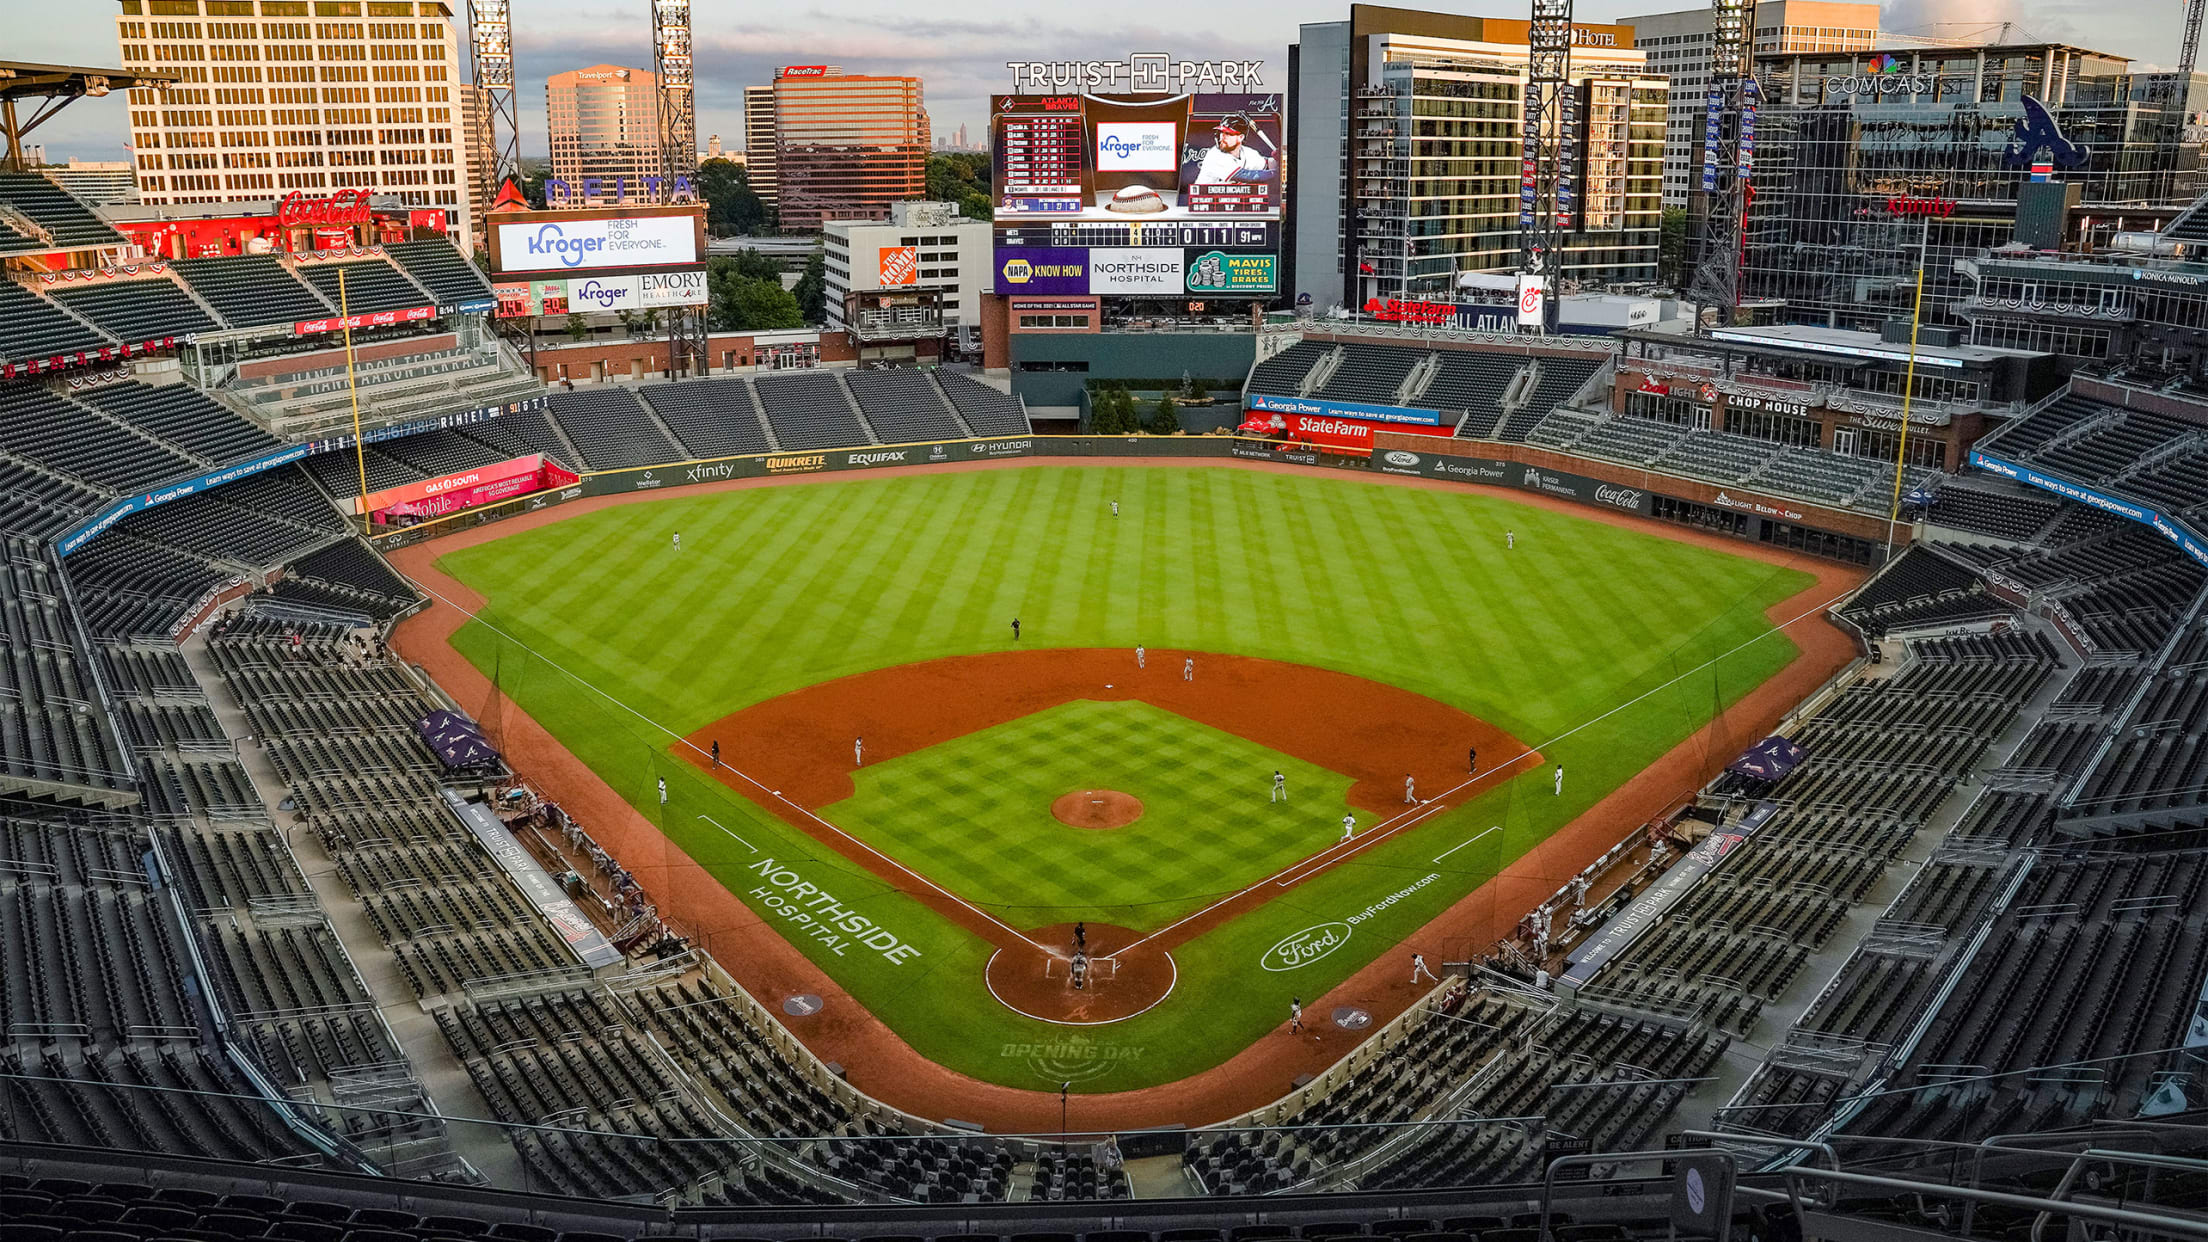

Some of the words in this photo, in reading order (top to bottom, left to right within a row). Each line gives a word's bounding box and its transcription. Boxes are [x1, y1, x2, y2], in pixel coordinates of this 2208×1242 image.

[1578, 28, 1618, 46] HOTEL
[578, 71, 612, 80] Travelport
[786, 67, 823, 76] RaceTrac
[1007, 61, 1123, 87] TRUIST
[1179, 60, 1264, 87] PARK
[1826, 75, 1934, 94] COMCAST
[1100, 135, 1142, 159] Kroger
[545, 176, 696, 207] DELTA
[279, 187, 375, 227] Coca-Cola
[1887, 193, 1957, 218] xfinity
[607, 219, 638, 230] FRESH
[608, 230, 630, 240] FOR
[1184, 229, 1192, 244] 0
[1203, 229, 1209, 244] 1
[1221, 229, 1227, 244] 1
[1240, 231, 1251, 243] 91
[528, 223, 606, 267] Kroger
[609, 239, 662, 250] EVERYONE
[880, 246, 917, 284] HOME
[882, 251, 898, 266] THE
[1228, 259, 1271, 268] MAVIS
[894, 261, 916, 284] DEPOT
[1007, 264, 1029, 278] NAPA
[1034, 265, 1060, 277] KNOW
[1062, 265, 1083, 277] HOW
[1094, 263, 1180, 274] NORTHSIDE
[642, 272, 704, 291] EMORY
[1110, 275, 1164, 283] HOSPITAL
[2141, 271, 2168, 282] KONICA
[2168, 274, 2198, 285] MINOLTA
[578, 280, 628, 307] Kroger
[642, 289, 702, 300] HEALTHCARE
[373, 312, 395, 324] Coca-Cola
[406, 308, 428, 319] Coca-Cola
[440, 305, 454, 314] 8:14
[303, 321, 327, 332] Coca-Cola
[1477, 315, 1520, 334] ATLAN
[1638, 380, 1669, 395] Coors
[1669, 387, 1697, 399] LIGHT
[1267, 400, 1297, 412] Georgia
[1298, 404, 1322, 414] Power
[1328, 408, 1344, 416] Learn
[1344, 410, 1358, 418] ways
[1385, 414, 1435, 423] georgiapower.com
[1728, 395, 1761, 409] CHOP
[1765, 400, 1808, 417] HOUSE
[441, 417, 448, 428] R
[456, 413, 463, 425] H
[472, 410, 477, 422] E
[1850, 416, 1862, 424] THE
[989, 440, 1032, 451] HYUNDAI
[766, 455, 827, 469] QUIKRETE
[848, 451, 906, 465] EQUIFAX
[1391, 452, 1414, 465] Ford
[154, 490, 176, 503] Georgia
[177, 485, 194, 498] Power
[206, 475, 222, 486] Learn
[222, 471, 236, 483] ways
[236, 468, 243, 477] to
[243, 466, 256, 475] save
[256, 464, 262, 472] at
[262, 449, 305, 471] georgiapower.com
[686, 463, 734, 482] xfinity
[1447, 464, 1478, 477] Georgia
[1480, 467, 1504, 478] Power
[426, 483, 443, 494] GAS
[452, 473, 479, 487] SOUTH
[473, 482, 498, 495] AMERICA'S
[498, 479, 511, 489] MOST
[511, 474, 533, 487] RELIABLE
[499, 484, 520, 495] COVERAGE
[636, 478, 661, 487] Wellstar
[1984, 459, 2002, 474] Georgia
[2002, 465, 2018, 477] Power
[2028, 473, 2044, 485] Learn
[2044, 478, 2059, 490] ways
[2058, 483, 2066, 492] to
[2066, 486, 2079, 496] save
[2080, 490, 2087, 499] at
[2087, 493, 2142, 519] georgiapower.com
[1595, 484, 1642, 509] Coca-Cola
[1755, 504, 1777, 515] BELOW
[1784, 510, 1803, 520] CHOP
[486, 827, 511, 851] TRUIST
[1347, 872, 1441, 926] BuyFordNow.com
[749, 857, 922, 966] NORTHSIDE
[749, 886, 851, 956] HOSPITAL
[1580, 943, 1606, 963] WELCOME
[1603, 938, 1612, 948] TO
[1609, 912, 1643, 938] TRUIST
[1648, 887, 1673, 907] PARK
[1277, 928, 1340, 965] Ford
[1000, 1043, 1098, 1059] OPENING
[1104, 1046, 1145, 1060] DAY
[1549, 1141, 1561, 1149] BE
[1562, 1140, 1590, 1149] ALERT
